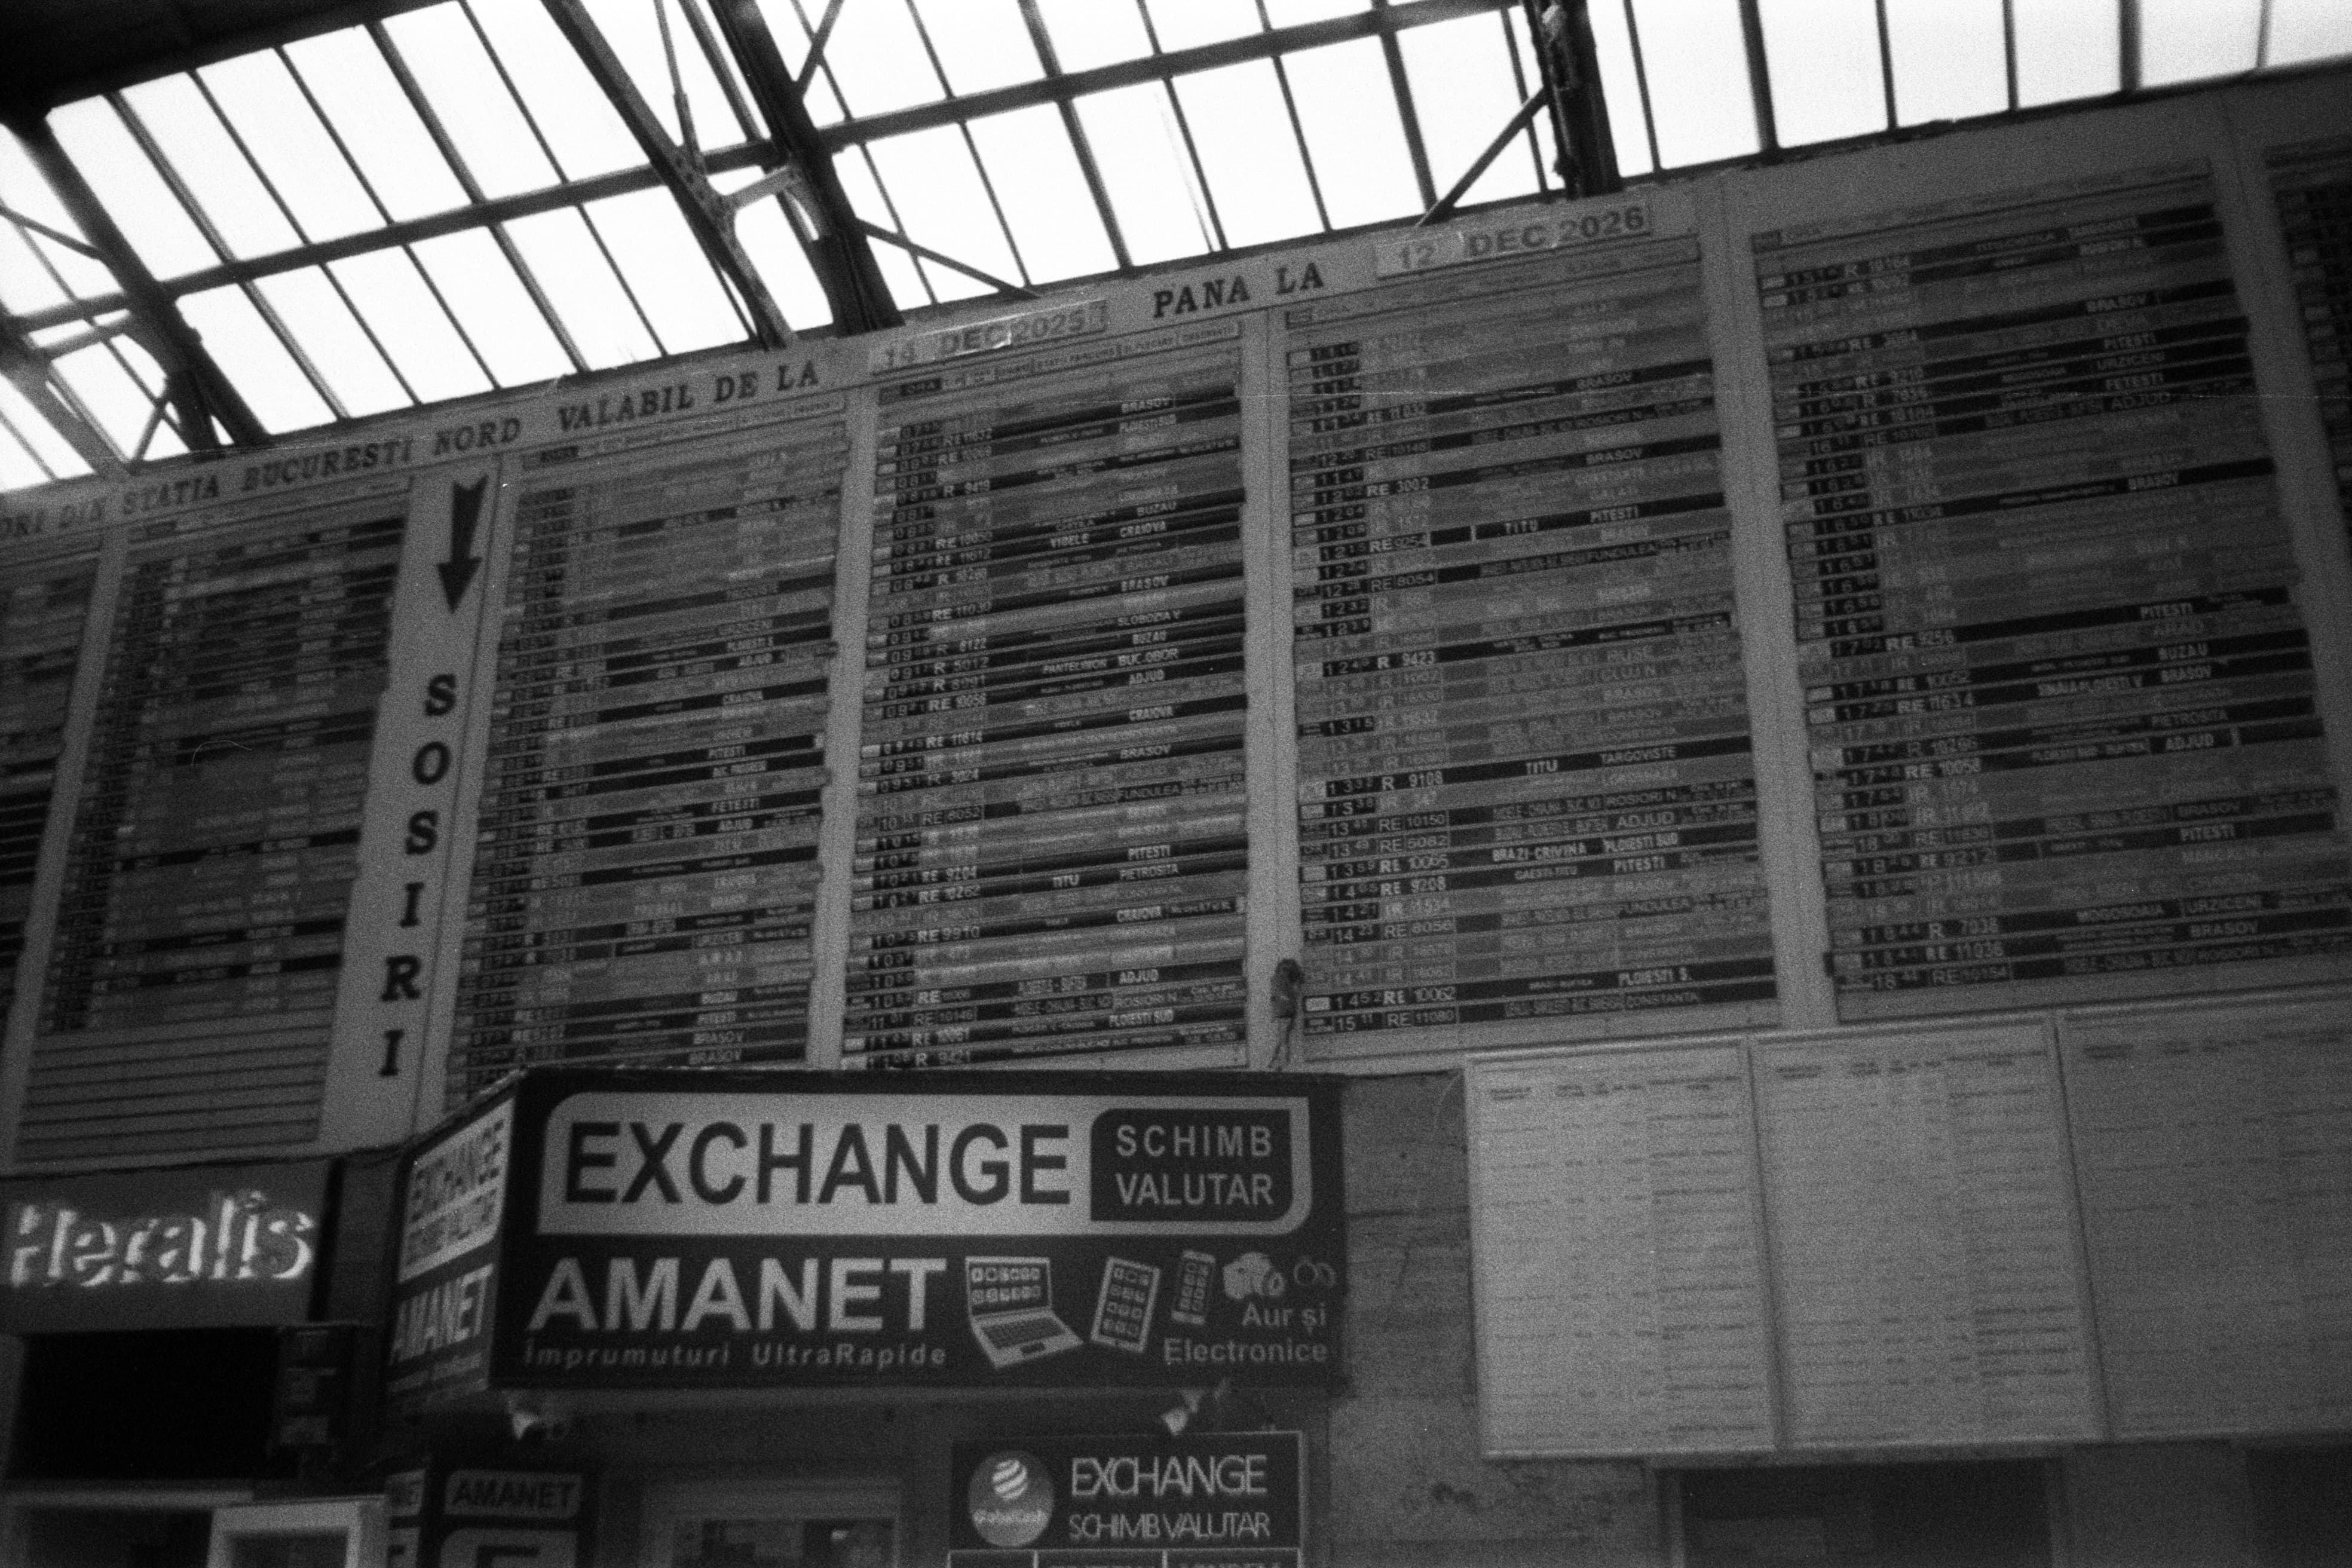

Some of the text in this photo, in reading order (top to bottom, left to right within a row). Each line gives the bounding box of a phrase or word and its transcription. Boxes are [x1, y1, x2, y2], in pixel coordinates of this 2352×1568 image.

[1399, 206, 1645, 270] 12 DEC 2026
[1153, 261, 1324, 318] PANA LA
[941, 325, 1004, 354] DEC
[1013, 308, 1085, 342] 2025
[1577, 374, 1631, 390] BRASOV
[2111, 391, 2171, 411] ADJUD
[123, 474, 219, 515] STATIA
[241, 439, 414, 492] BUCURESTI
[433, 418, 521, 456] NORD
[558, 375, 693, 430] VALABIL
[715, 370, 760, 404] DE
[778, 360, 819, 391] LA
[1367, 483, 1389, 497] RE
[1585, 448, 1643, 465] BRASOV
[1370, 538, 1392, 553] RE
[1371, 578, 1392, 592] RE
[1886, 635, 1914, 651] RE
[2140, 603, 2193, 619] PITESTI
[1377, 651, 1435, 669] R 9423
[2158, 642, 2208, 661] BUZAU
[1898, 699, 1925, 713] RE
[2161, 665, 2212, 683] BRASOV
[929, 697, 951, 712] RE
[1120, 745, 1170, 760] BRASOV
[1904, 733, 2215, 779] RE ADJUD
[1382, 776, 1394, 791] R
[1526, 760, 1558, 775] TITU
[922, 811, 942, 825] RE
[1379, 818, 1401, 831] RE
[1915, 799, 2240, 847] RE BRASOV
[1380, 839, 1402, 853] RE
[1616, 811, 1674, 830] ADJUD
[2179, 823, 2235, 842] PITESTI
[1128, 844, 1170, 861] PITESTI
[378, 673, 457, 1076] SOSIRI
[1380, 859, 1401, 873] RE
[1380, 882, 1401, 897] RE
[1614, 856, 1665, 872] PITESTI
[917, 929, 939, 942] RE
[1383, 924, 1407, 938] RE
[1928, 923, 1944, 940] R
[2190, 920, 2258, 938] BRASOV
[917, 990, 941, 1004] RE
[1383, 990, 1405, 1004] RE
[1388, 1013, 1411, 1027] RE
[1116, 1124, 1273, 1157] SCHIMB
[565, 1121, 1071, 1205] EXCHANGE
[1114, 1173, 1275, 1206] VALUTAR
[525, 1257, 948, 1331] AMANET
[1241, 1301, 1293, 1327] Aur
[752, 1343, 947, 1370] UltraRapide
[1163, 1338, 1328, 1364] Electronice
[1071, 1454, 1268, 1496] EXCHANGE
[451, 1478, 575, 1510] AMANET
[1068, 1513, 1160, 1541] SCHIMB
[1163, 1511, 1271, 1539] VALUTAR
